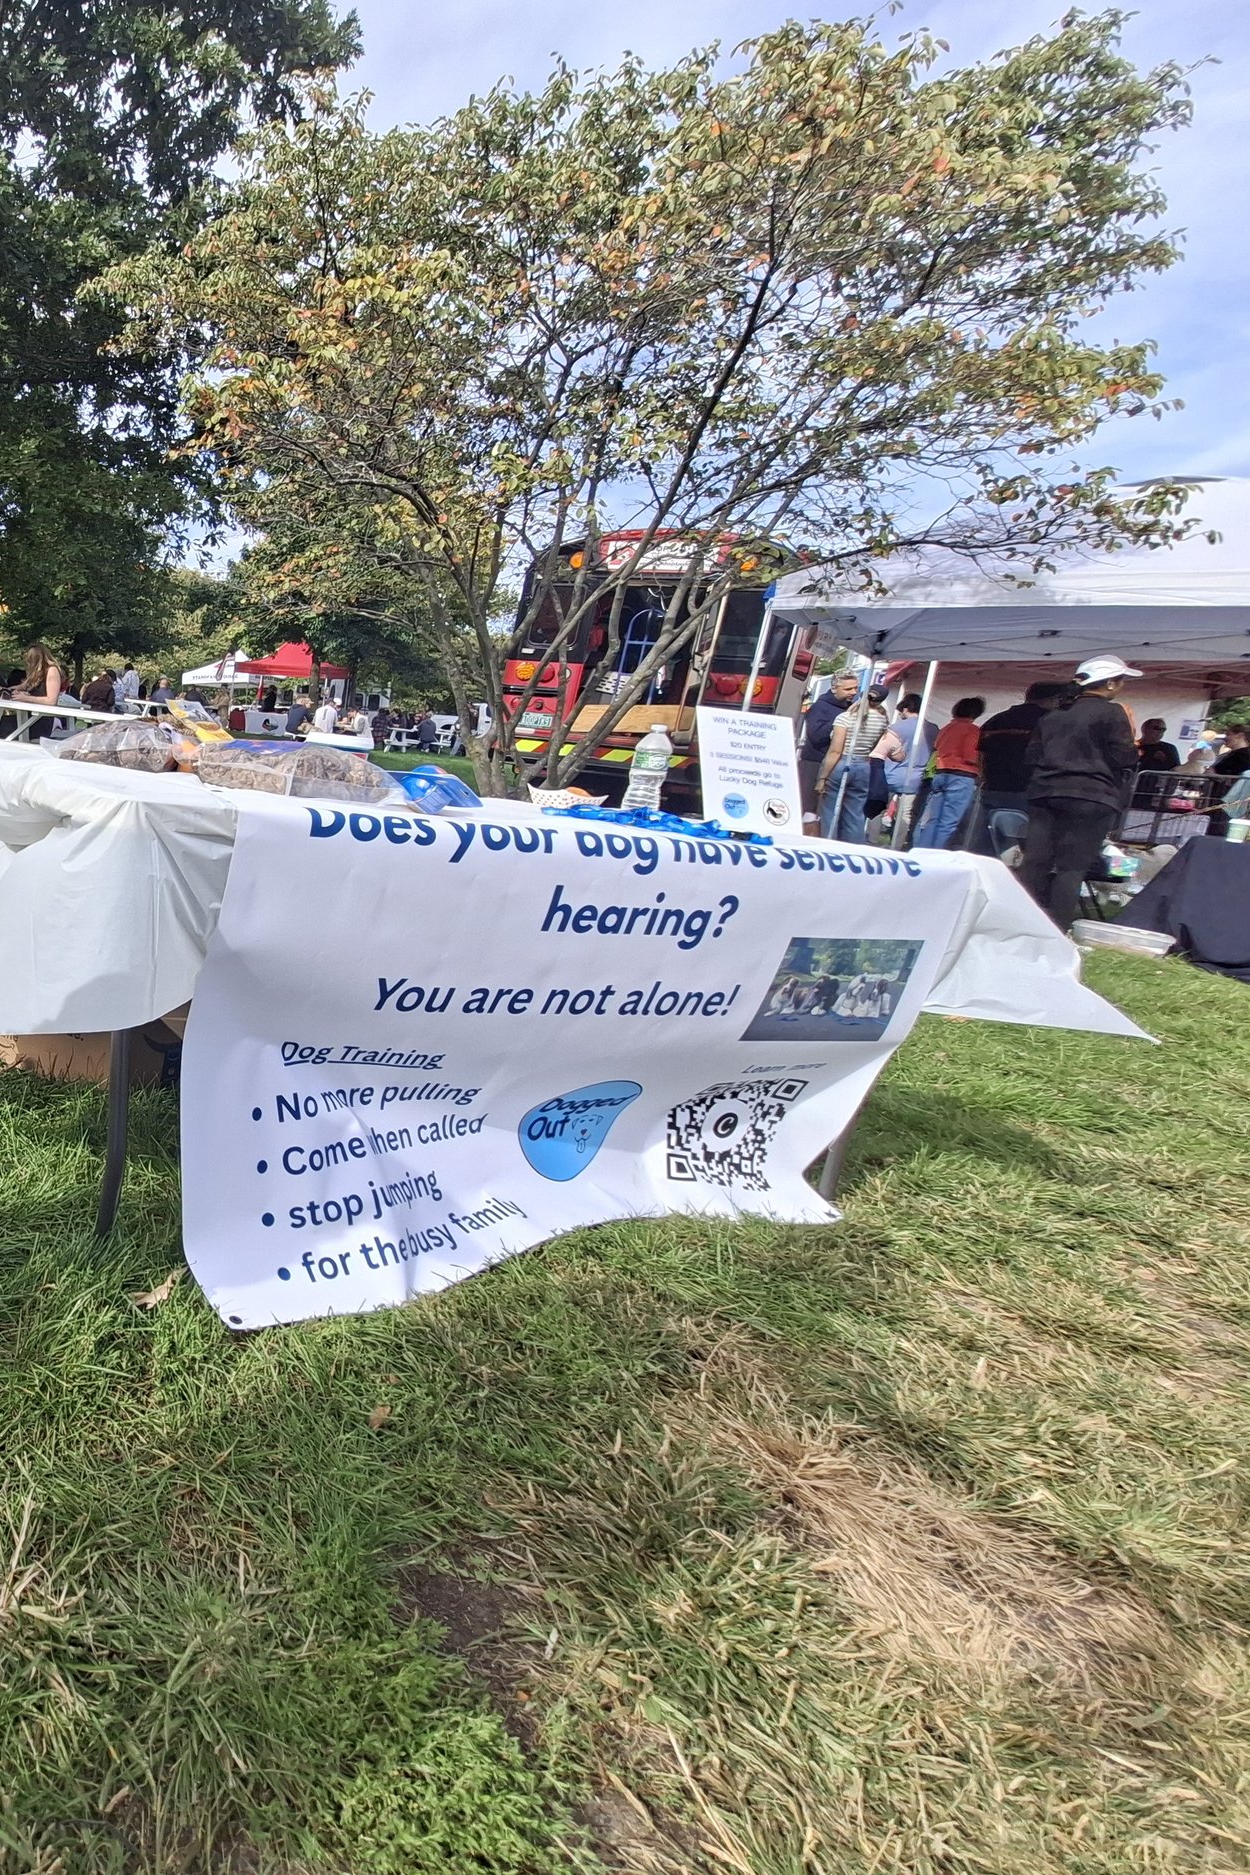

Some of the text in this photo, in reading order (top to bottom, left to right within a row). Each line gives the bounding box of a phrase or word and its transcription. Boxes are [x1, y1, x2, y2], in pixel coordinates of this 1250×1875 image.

[728, 727, 766, 739] PACKAGE
[738, 719, 777, 730] TRAINING
[743, 743, 766, 751] ENTRY
[719, 775, 783, 789] Lucky Dog Refuge
[729, 768, 761, 777] proceeds
[303, 807, 437, 846] Does
[446, 820, 558, 863] your
[575, 829, 659, 875] dog
[666, 836, 768, 868] have
[540, 885, 739, 950] hearing?
[373, 977, 742, 1017] You are not alone!
[281, 1041, 447, 1070] Dog Training
[741, 1063, 828, 1074] Learn more
[275, 1083, 482, 1123] No more pulling
[539, 1093, 638, 1115] Dogged
[527, 1113, 570, 1141] Out
[282, 1136, 367, 1175] Come
[417, 1112, 489, 1145] called
[289, 1170, 442, 1229] stop jumping
[301, 1197, 527, 1283] for the busy family
